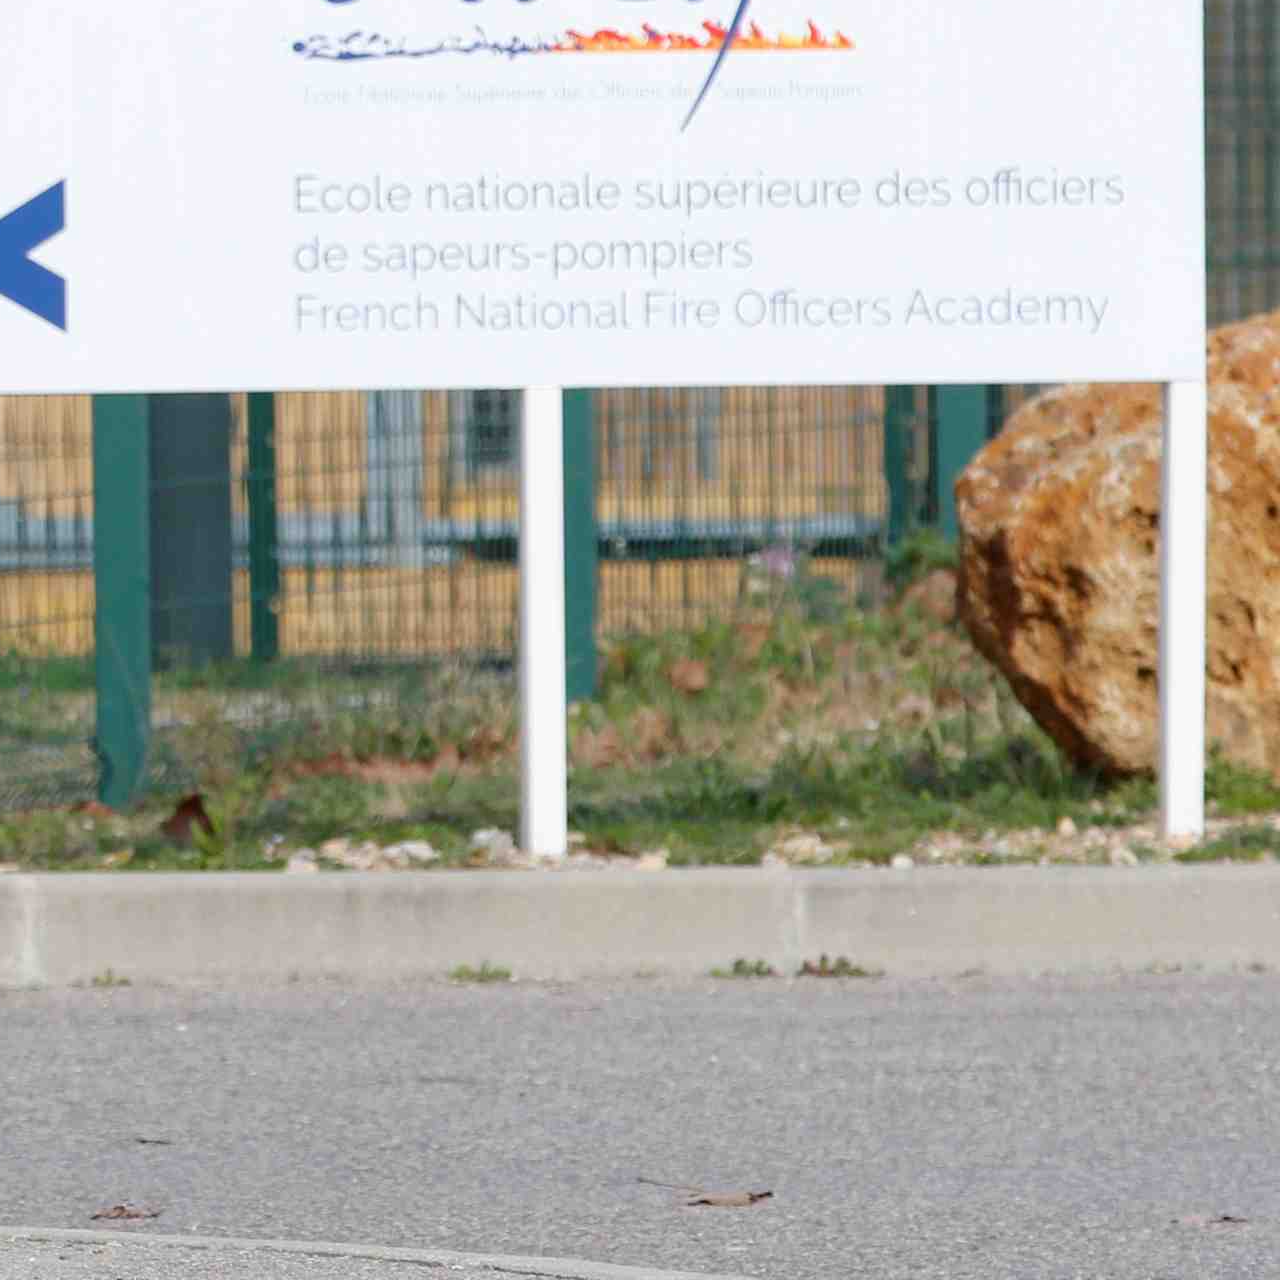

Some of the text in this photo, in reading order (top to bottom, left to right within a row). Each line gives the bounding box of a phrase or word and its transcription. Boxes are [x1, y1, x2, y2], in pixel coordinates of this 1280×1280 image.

[293, 165, 1125, 219] Ecole nationale supérieure des officiers
[293, 231, 754, 280] de sapeurs-pompiers
[294, 286, 1109, 334] French National Fire Officers Academy
